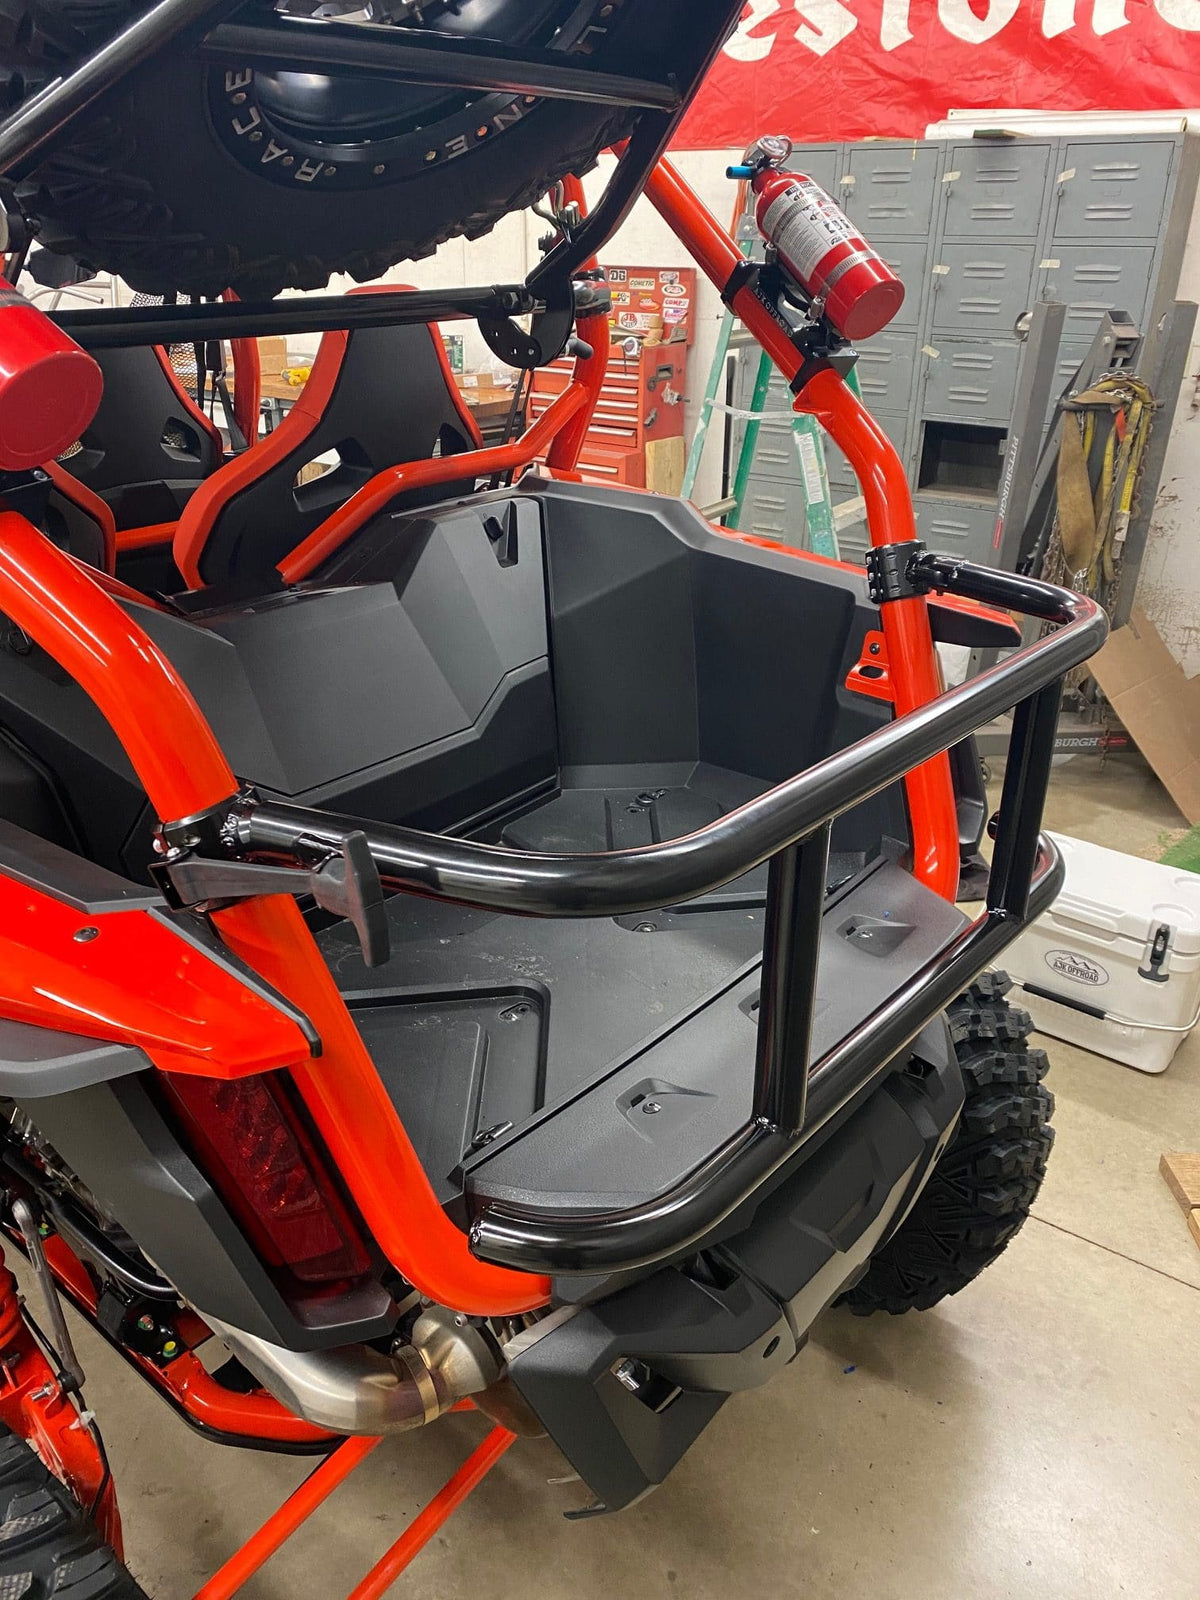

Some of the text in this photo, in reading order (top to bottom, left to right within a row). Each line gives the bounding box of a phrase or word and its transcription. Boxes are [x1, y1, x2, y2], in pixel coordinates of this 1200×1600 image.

[999, 436, 1019, 519] PITTSBURGH
[1053, 960, 1099, 982] AJK OFFROAD
